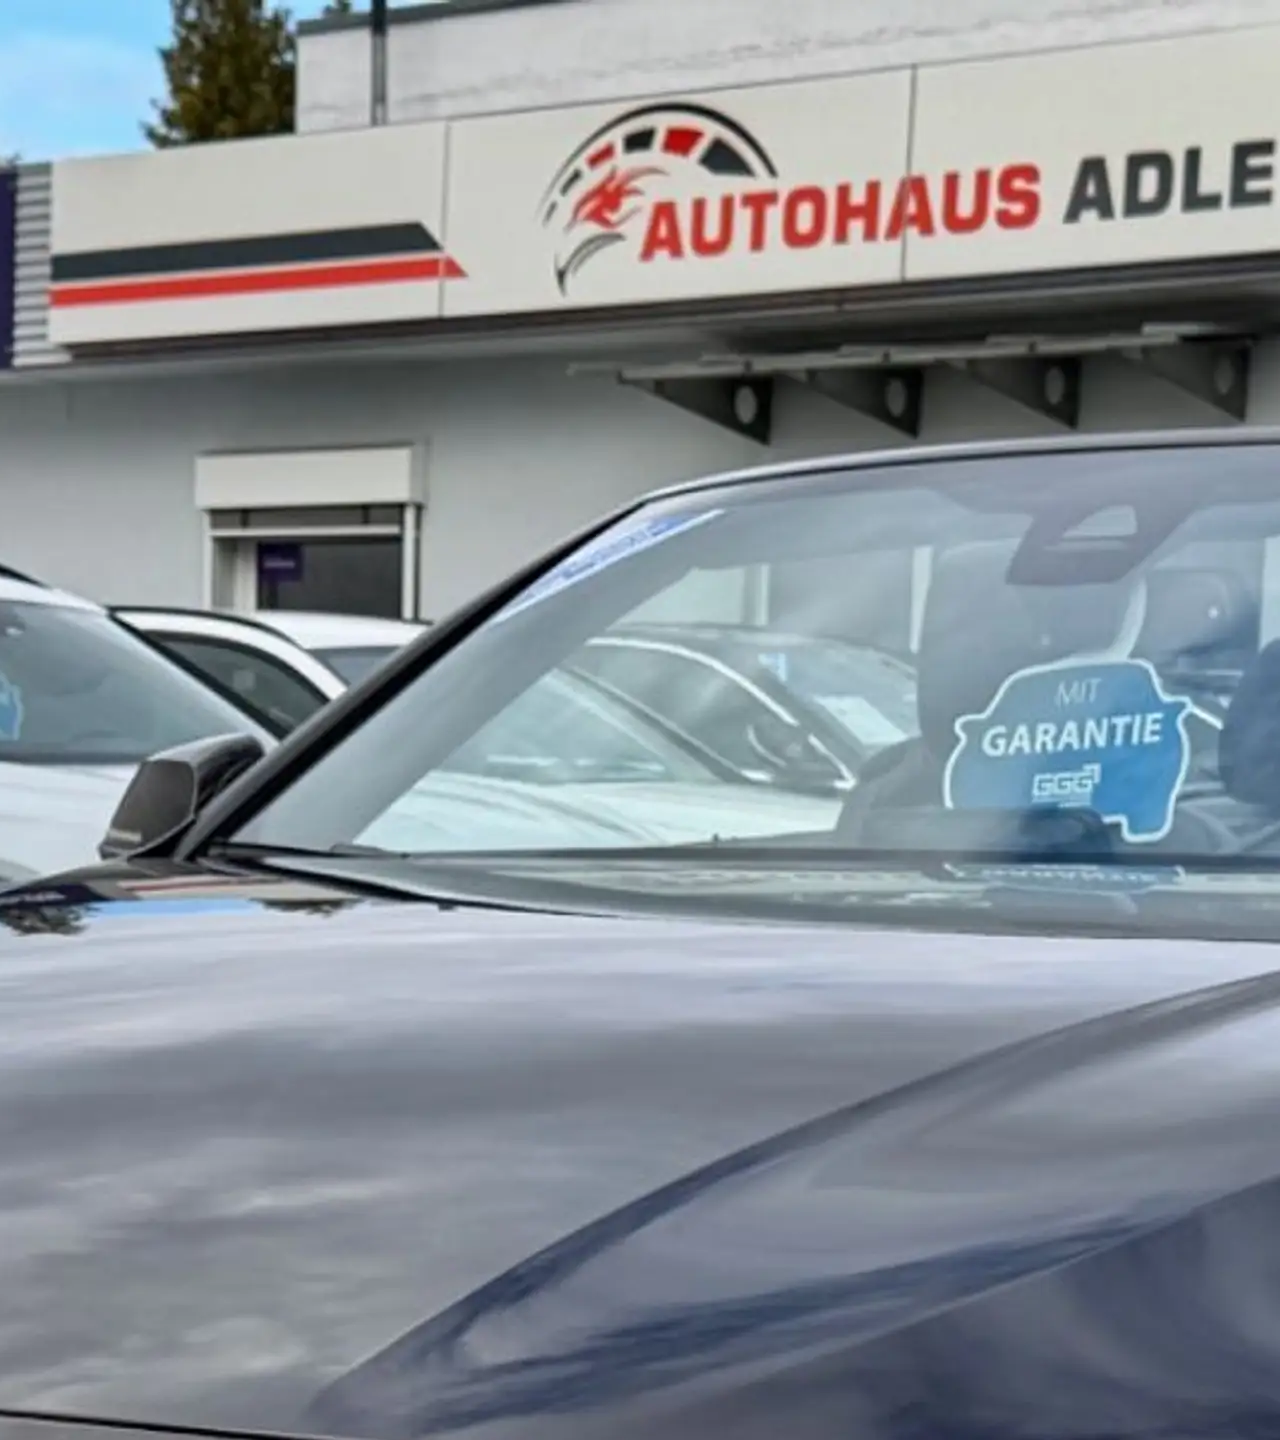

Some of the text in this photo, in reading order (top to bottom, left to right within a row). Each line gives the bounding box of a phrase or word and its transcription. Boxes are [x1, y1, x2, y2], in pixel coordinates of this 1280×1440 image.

[639, 163, 1041, 262] AUTOHAUS
[1055, 678, 1102, 705] MIT
[982, 712, 1164, 757] GARANTIE
